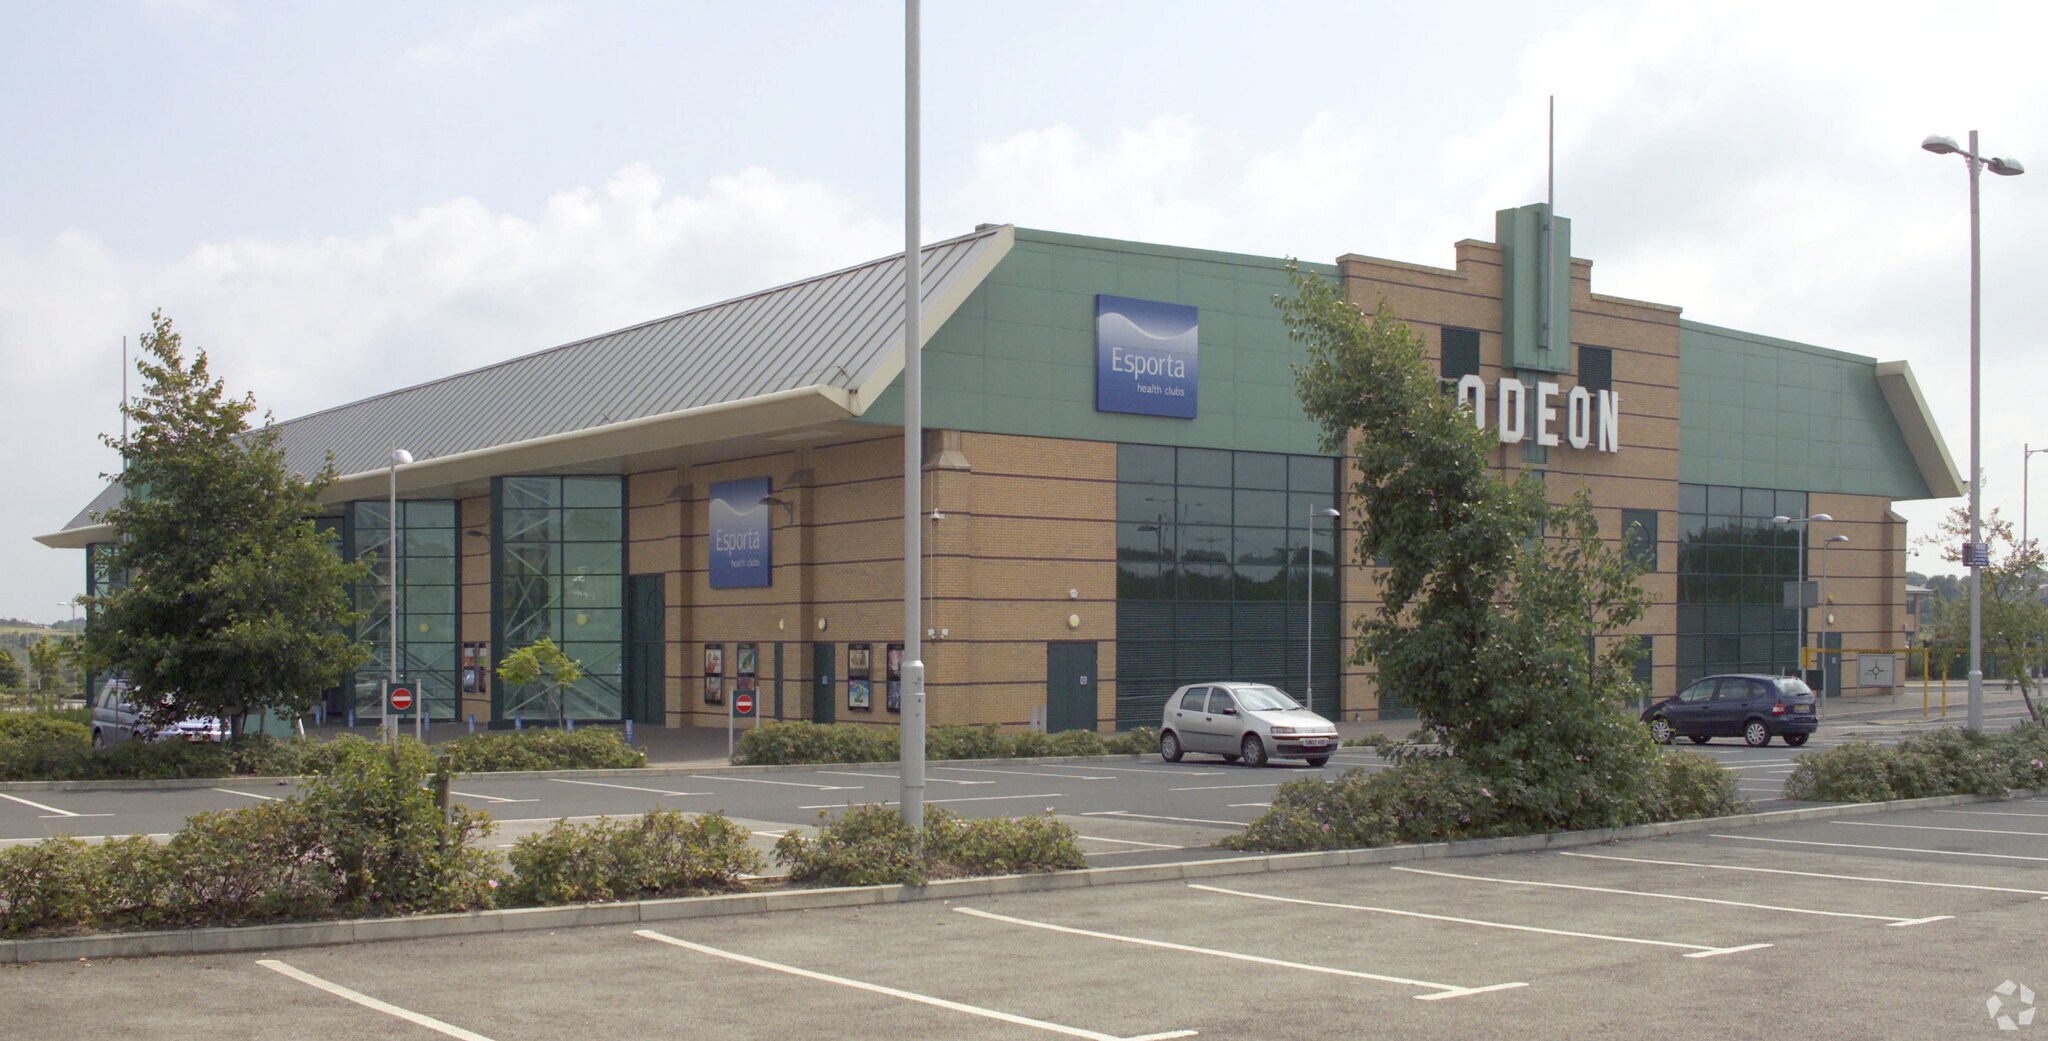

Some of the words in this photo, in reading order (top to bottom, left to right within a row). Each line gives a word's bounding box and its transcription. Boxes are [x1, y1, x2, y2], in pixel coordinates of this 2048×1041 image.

[1112, 347, 1185, 380] Esporta
[1137, 383, 1162, 395] health
[1164, 386, 1185, 397] clubs
[1457, 374, 1619, 453] ODEON
[716, 529, 760, 557] Esporta
